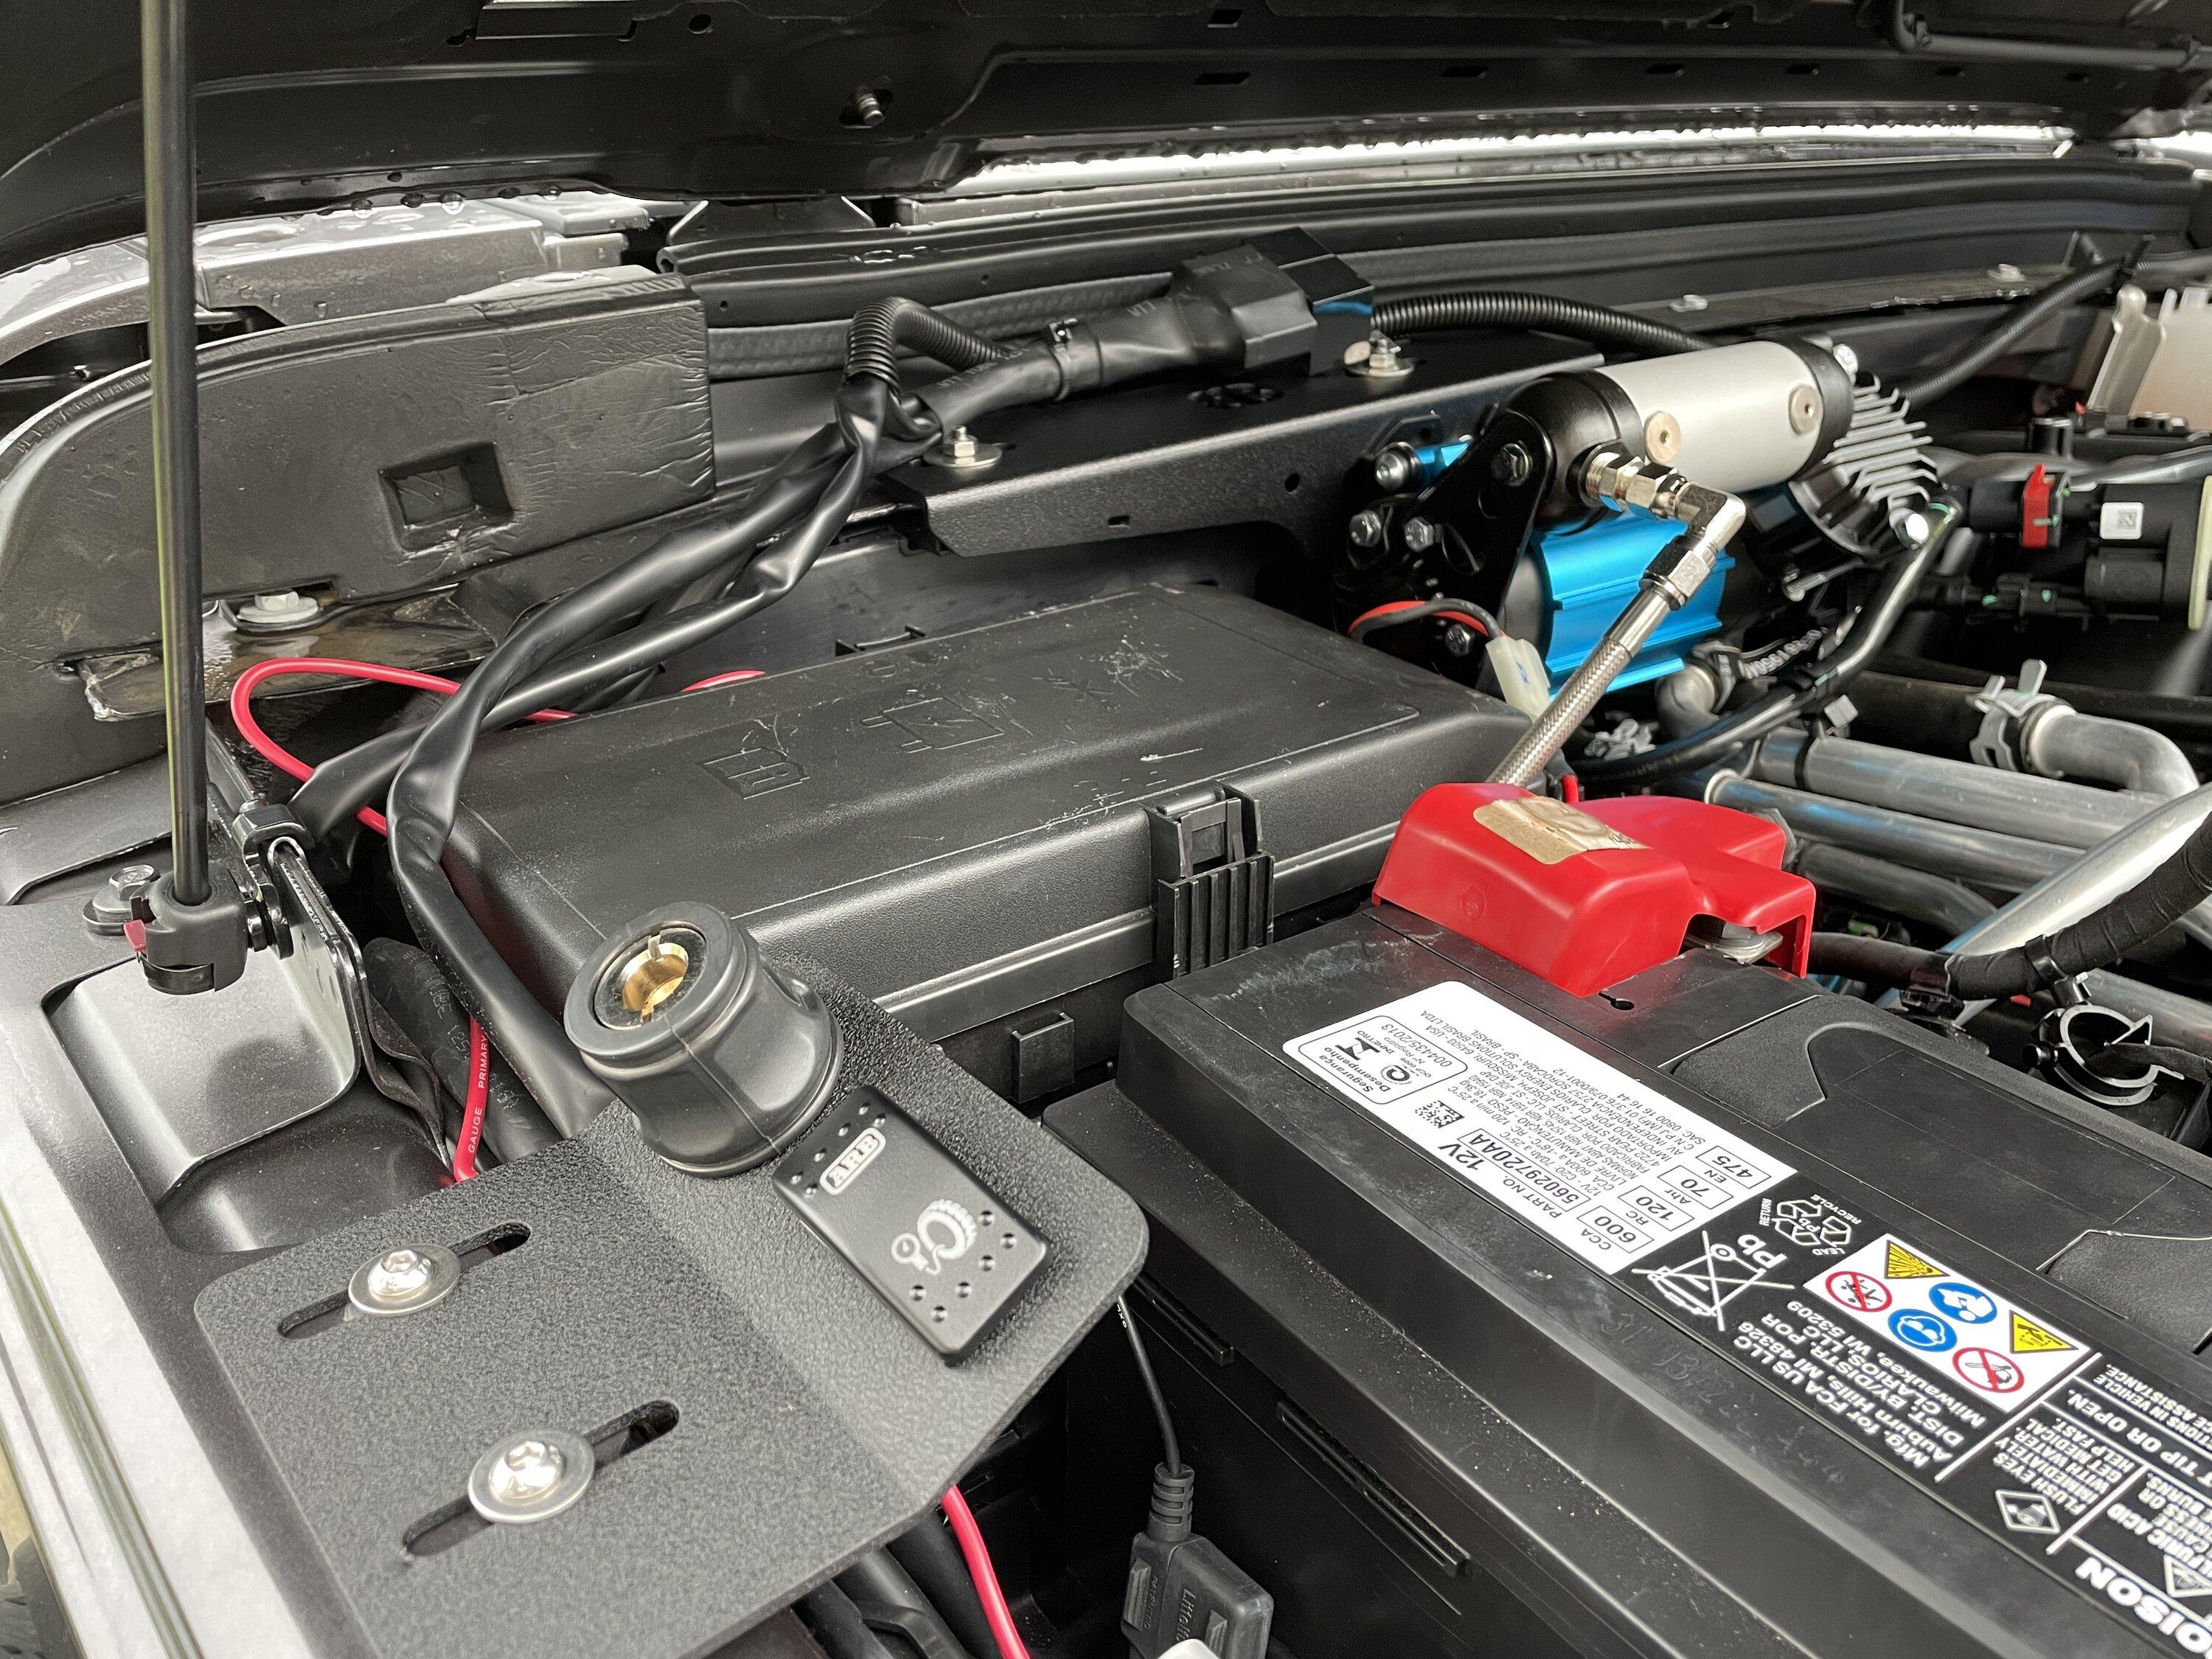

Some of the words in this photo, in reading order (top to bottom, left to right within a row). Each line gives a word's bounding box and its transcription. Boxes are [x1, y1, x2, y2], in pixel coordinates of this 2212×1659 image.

[1425, 1025, 1445, 1037] USA
[1441, 1023, 1472, 1042] BRASIL
[1470, 1029, 1502, 1049] BRASIL
[1381, 1023, 1453, 1067] 004435/2013
[1383, 1037, 1415, 1057] Registro
[1468, 1040, 1518, 1070] SOLUTIONS
[1503, 1051, 1520, 1060] SP
[1318, 1054, 1374, 1092] Segurança
[1324, 1047, 1391, 1092] Desempenho
[1479, 1071, 1500, 1082] DAP
[1514, 1068, 1554, 1091] ENERGY
[1522, 1060, 1571, 1090] SOROCABA
[467, 1107, 482, 1153] GAUGE
[478, 1034, 488, 1089] PRIMARY
[1495, 1079, 1514, 1090] JOE
[1517, 1079, 1556, 1102] JOSEPH,
[1568, 1089, 1594, 1103] 2757
[1616, 1093, 1631, 1102] 44
[1475, 1102, 1495, 1115] min
[1526, 1098, 1547, 1110] LLC
[1549, 1088, 1592, 1114] CLARIOS
[1629, 1100, 1644, 1110] 16
[1641, 1107, 1657, 1116] 16
[1491, 1113, 1511, 1125] 120
[1544, 1107, 1582, 1133] CLARIOS,
[1571, 1114, 1610, 1137] STREET
[1591, 1101, 1667, 1147] INDEPENDÊNCIA
[1655, 1115, 1682, 1131] 0800
[1438, 1143, 1484, 1170] 12V
[1607, 1135, 1637, 1152] PEAR
[1613, 1126, 1672, 1162] IMPORTADO
[1665, 1144, 1685, 1155] AV.
[827, 1134, 880, 1189] ARB
[1470, 1134, 1579, 1203] 56029720AA
[1530, 1150, 1555, 1167] 70Ah
[1565, 1158, 1591, 1176] 600A
[1579, 1156, 1598, 1167] DE
[1599, 1143, 1650, 1174] FABRICADO
[1601, 1156, 1638, 1180] NORMAS
[1633, 1150, 1660, 1166] 4722
[1711, 1155, 1753, 1178] 475
[1502, 1175, 1526, 1193] NO.
[1593, 1166, 1627, 1186] LIVRE
[1680, 1178, 1710, 1197] 70
[1703, 1169, 1727, 1183] EN
[1579, 1183, 1601, 1197] 12V
[1663, 1189, 1691, 1204] Ahr
[1522, 1193, 1562, 1218] PART
[1625, 1210, 1649, 1225] RC
[1635, 1196, 1674, 1220] 120
[1759, 1197, 1772, 1226] RETURN
[1810, 1194, 1862, 1225] RECYCLE
[1593, 1216, 1636, 1243] 600
[1798, 1217, 1821, 1233] Pb
[1580, 1228, 1612, 1251] CCA
[1737, 1234, 1787, 1268] Pb
[1761, 1313, 1806, 1344] POR
[1787, 1301, 1845, 1338] 53209
[1733, 1335, 1775, 1364] LLC
[1738, 1322, 1795, 1359] 48326
[1802, 1325, 1844, 1352] LLC
[1842, 1335, 1871, 1356] WI
[1772, 1360, 1804, 1384] US
[1793, 1358, 1824, 1379] MI
[1810, 1342, 1906, 1408] BY/DISTR.
[1848, 1349, 1941, 1414] CLARIOS,
[1805, 1380, 1848, 1413] FCA
[1827, 1375, 1875, 1413] Hills,
[1877, 1352, 1985, 1427] Milwaukee,
[2093, 1374, 2151, 1411] VEHICLE
[2106, 1364, 2196, 1421] ASSISTANCE.
[1846, 1411, 1879, 1434] for
[2067, 1389, 2127, 1432] OPEN.
[2149, 1405, 2169, 1421] IN
[1875, 1409, 1952, 1461] Auburn
[1907, 1406, 1964, 1446] DIST.
[2052, 1418, 2095, 1448] FAST.
[1884, 1430, 1930, 1467] Mfg.
[2014, 1427, 2068, 1467] WATER.
[2026, 1418, 2091, 1464] MEDICAL
[2126, 1427, 2162, 1453] OR
[1993, 1452, 2036, 1483] EYES
[1995, 1437, 2098, 1503] IMMEDIATELY
[2087, 1459, 2122, 1484] GET
[2090, 1445, 2135, 1472] HELP
[2160, 1451, 2198, 1476] TIP
[2065, 1462, 2109, 1494] WITH
[2031, 1477, 2086, 1515] FLUSH
[2138, 1488, 2166, 1509] OR
[2107, 1503, 2152, 1534] ACID
[2152, 1514, 2209, 1553] CAUSE
[2075, 1557, 2212, 1659] OISON
